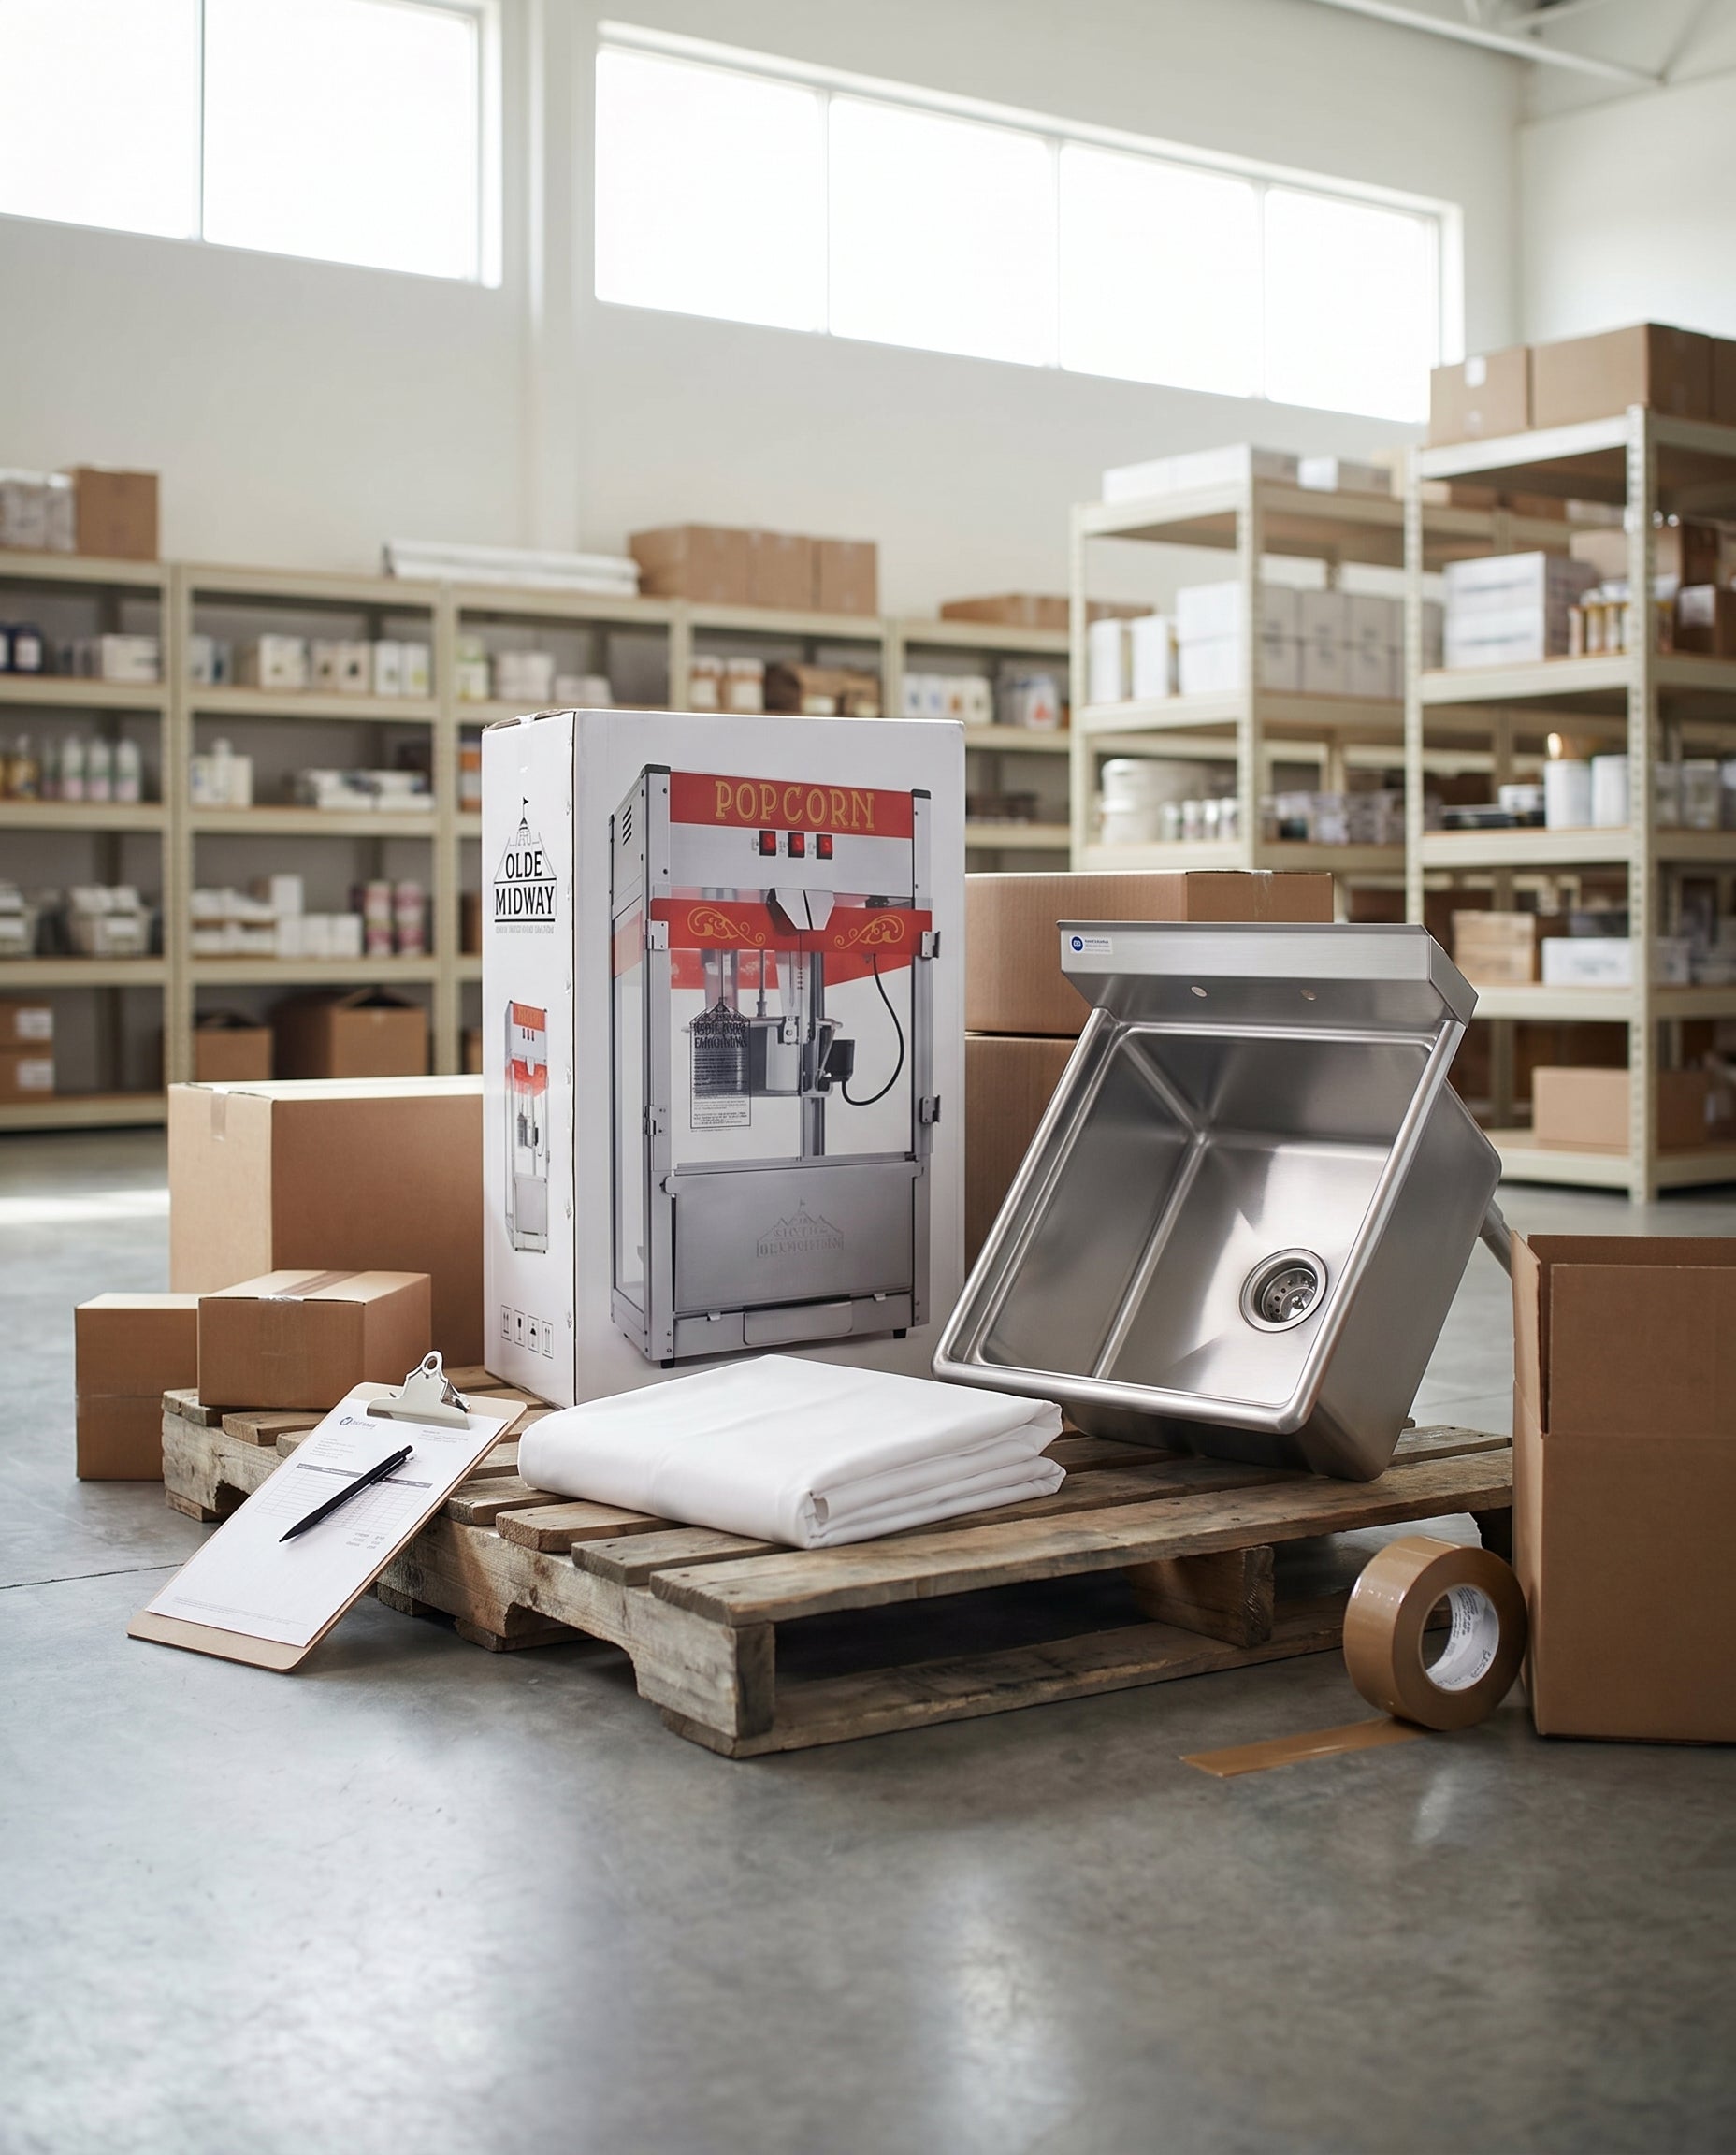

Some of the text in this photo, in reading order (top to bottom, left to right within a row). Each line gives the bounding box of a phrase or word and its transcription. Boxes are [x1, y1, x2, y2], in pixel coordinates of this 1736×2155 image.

[715, 780, 875, 830] POPCORN
[505, 850, 542, 879] OLDE
[496, 886, 555, 915] MIDWAY
